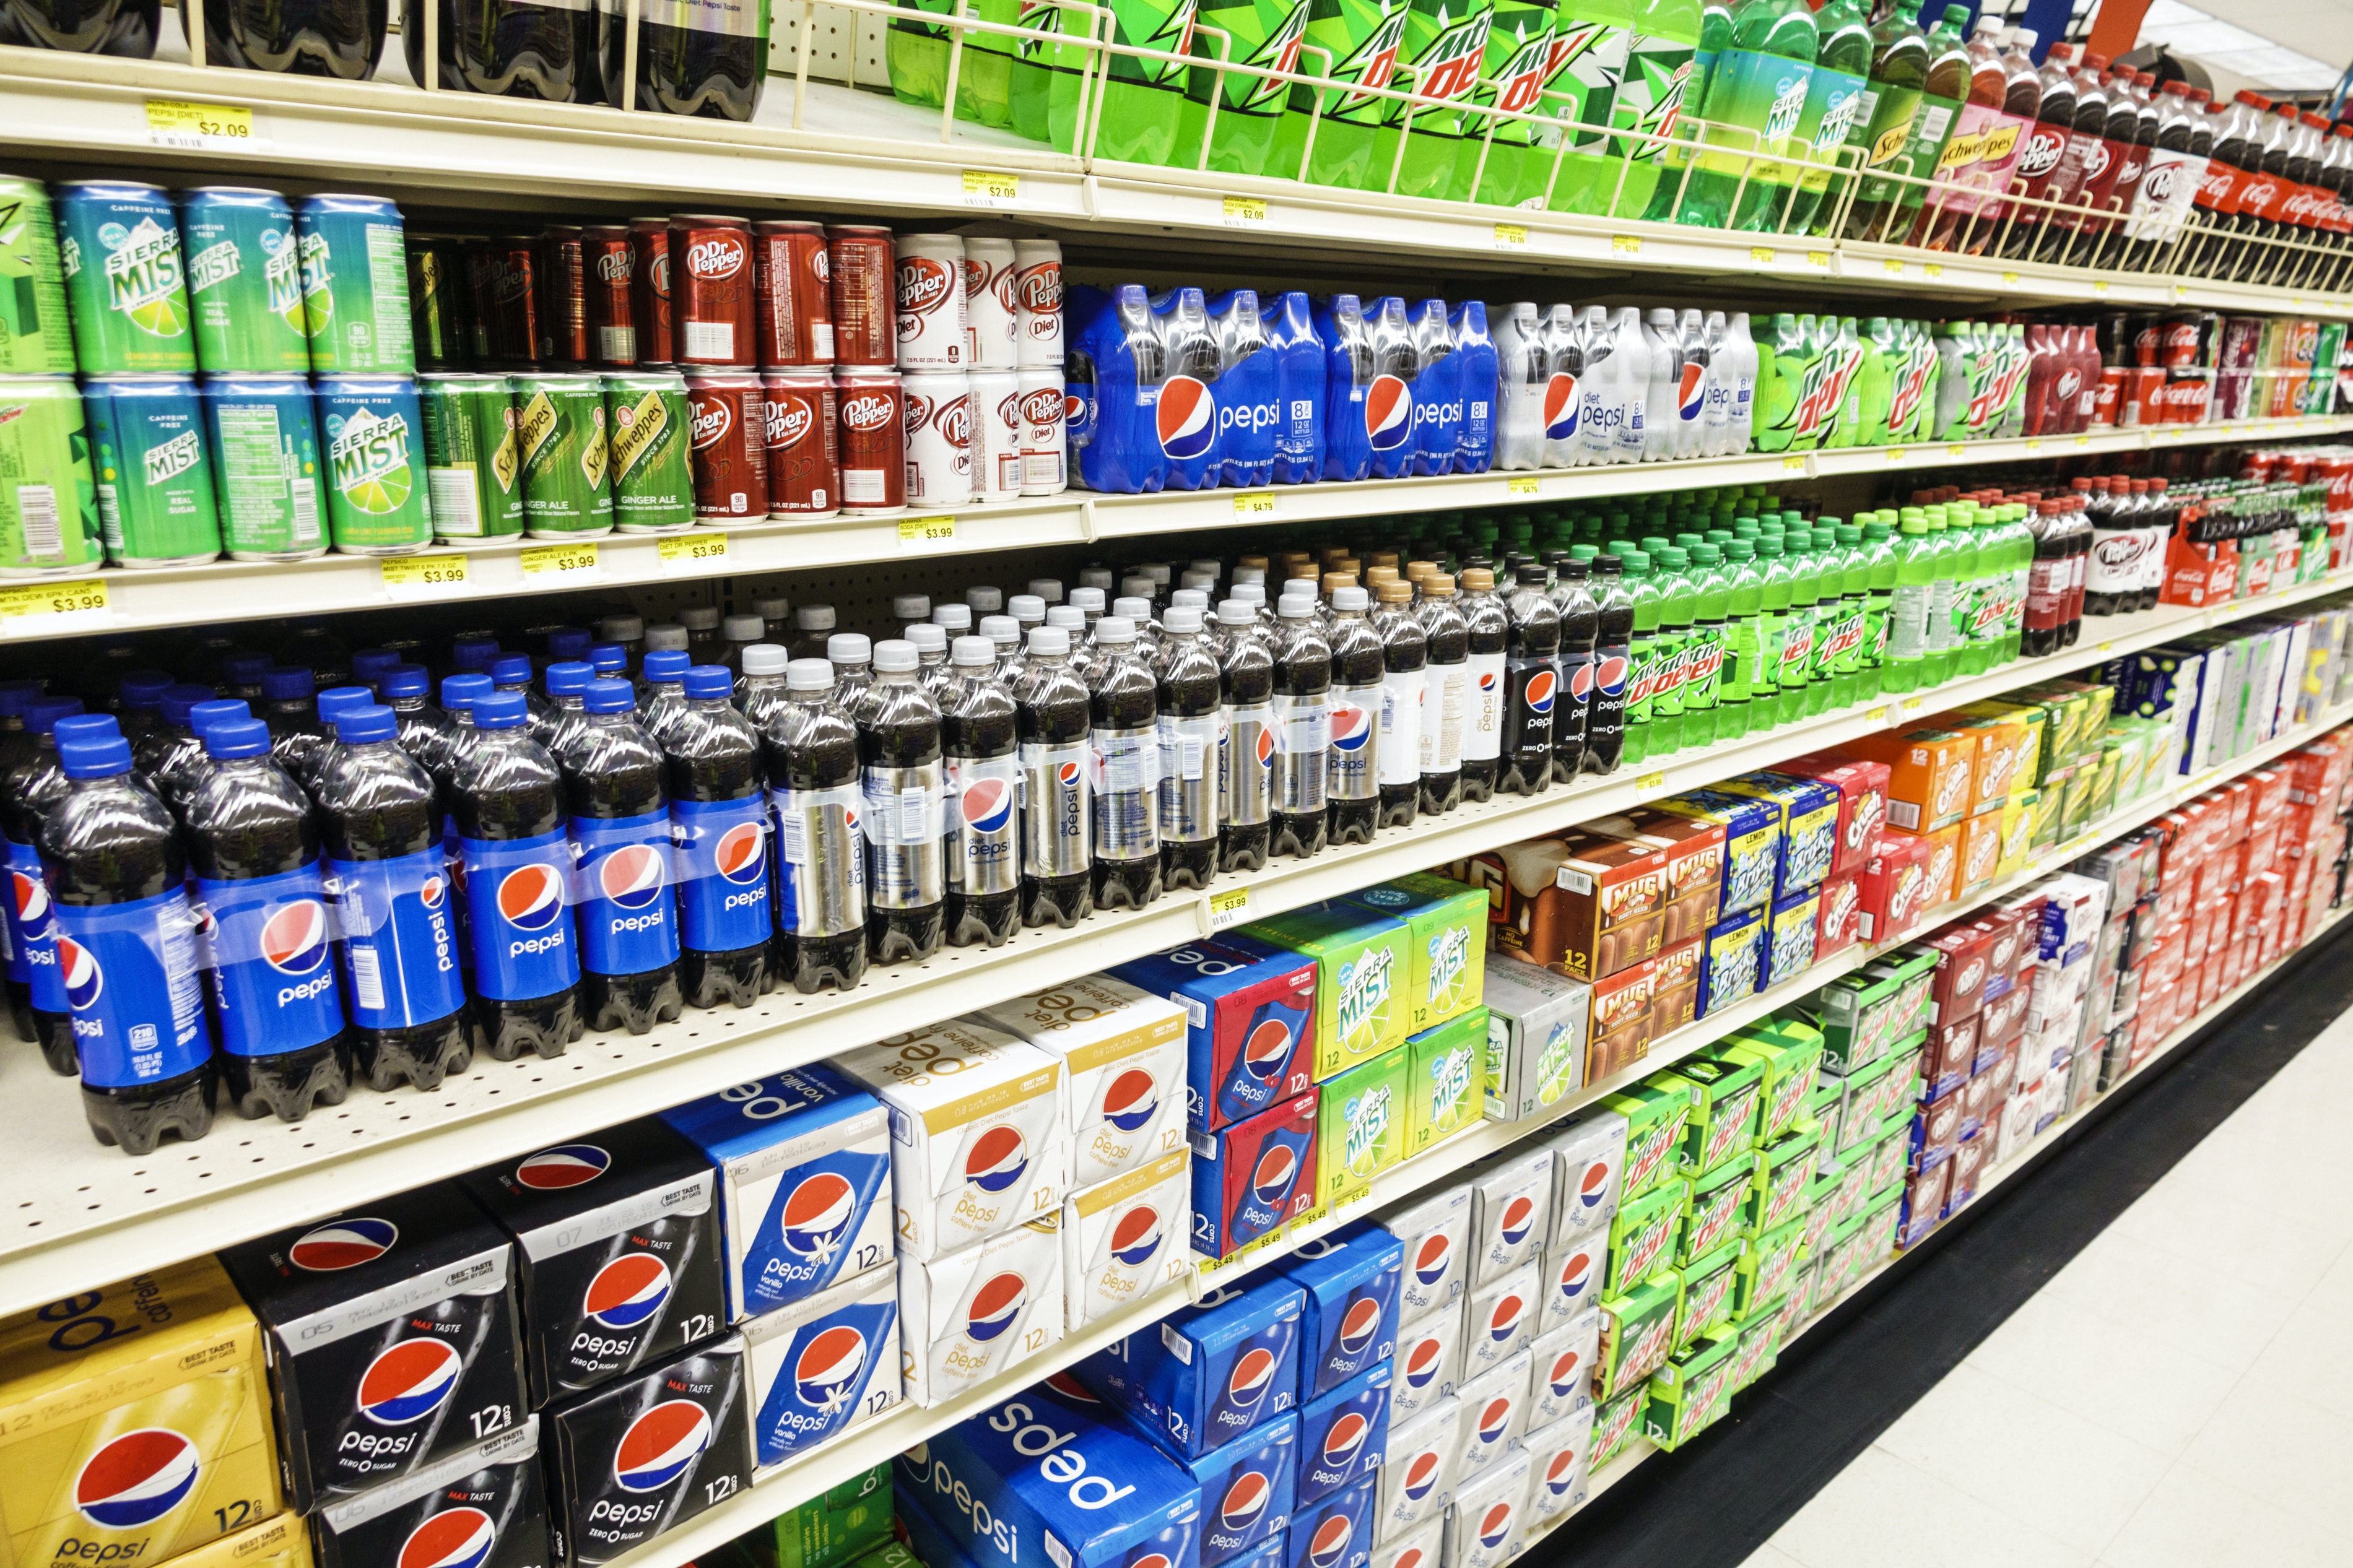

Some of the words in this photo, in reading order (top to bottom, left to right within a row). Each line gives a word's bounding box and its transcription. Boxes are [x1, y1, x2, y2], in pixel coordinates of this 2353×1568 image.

[149, 109, 173, 118] PEPSI
[199, 121, 248, 137] $2.09
[989, 186, 1016, 198] $2.09
[1243, 209, 1264, 220] $2.09
[1509, 235, 1525, 244] $2.09
[111, 229, 180, 270] SIERRA
[191, 243, 233, 271] SIERRA
[706, 241, 729, 260] Dr
[688, 245, 739, 275] Pepper
[191, 249, 237, 294] MIST
[1034, 319, 1055, 336] Diet
[861, 397, 880, 410] Dr
[1584, 392, 1600, 405] diet
[848, 401, 891, 427] Pepper
[1220, 398, 1280, 437] pepsi
[1294, 403, 1303, 418] 8
[1414, 398, 1463, 431] pepsi
[1581, 404, 1625, 433] pepsi
[1634, 403, 1640, 415] 8
[333, 415, 402, 457] SIERRA
[610, 403, 663, 475] Schweppes
[1034, 427, 1050, 438] Diet
[149, 431, 195, 461] SIERRA
[640, 444, 658, 466] SINCE
[658, 428, 671, 445] 1783
[149, 437, 199, 484] MIST
[334, 426, 409, 487] MIST
[171, 496, 193, 505] REAL
[549, 501, 569, 509] ALE
[622, 495, 658, 505] GINGER
[659, 495, 677, 504] ALE
[735, 495, 744, 503] 90
[1253, 503, 1273, 513] $4.79
[169, 505, 197, 514] SUGAR
[926, 527, 952, 539] $3.99
[659, 543, 674, 551] DIET
[692, 544, 724, 558] $3.99
[522, 553, 548, 563] GINGER
[549, 552, 563, 560] ALE
[559, 555, 595, 571] $3.99
[424, 570, 464, 584] $3.99
[22, 592, 44, 601] DEW
[67, 588, 93, 597] CANS
[53, 595, 105, 613] $3.99
[1482, 694, 1493, 732] pepsi
[1598, 698, 1626, 712] pepsi
[1330, 758, 1367, 773] pepsi
[1649, 779, 1663, 789] $3.99
[1064, 789, 1081, 836] pepsi
[1806, 810, 1824, 823] LEMON
[1746, 829, 1767, 845] LEMON
[968, 838, 1011, 859] pepsi
[850, 833, 864, 885] pepsi
[725, 882, 767, 911] pepsi
[1614, 875, 1657, 906] MUG
[1225, 897, 1246, 911] $3.99
[1617, 909, 1633, 920] ROOT
[1633, 903, 1649, 914] BEER
[611, 907, 664, 935] pepsi
[428, 911, 454, 972] pepsi
[510, 927, 565, 959] pepsi
[1497, 935, 1523, 946] CAFFEINE
[1646, 934, 1659, 951] 12
[1564, 949, 1588, 970] 12
[1339, 946, 1393, 1005] SIERRA
[1564, 965, 1586, 977] PACK
[278, 968, 333, 1008] pepsi
[1338, 959, 1393, 1031] MIST
[1327, 1052, 1340, 1068] 12
[1232, 1077, 1268, 1102] pepsi
[1290, 1072, 1305, 1093] 12
[1161, 1129, 1176, 1151] 12
[664, 1190, 682, 1202] BEST
[682, 1183, 701, 1195] TASTE
[1352, 1189, 1370, 1203] $5.49
[954, 1198, 1001, 1224] pepsi
[1243, 1205, 1274, 1227] pepsi
[1308, 1209, 1326, 1224] $5.49
[1261, 1232, 1281, 1248] $5.49
[763, 1256, 819, 1282] pepsi
[1213, 1254, 1233, 1270] $5.49
[760, 1275, 783, 1289] vanilla
[412, 1319, 434, 1330] MAX
[434, 1323, 463, 1334] TASTE
[185, 1350, 207, 1364] BEST
[209, 1340, 237, 1357] TASTE
[570, 1332, 635, 1358] pepsi
[1274, 1390, 1287, 1414] 12
[777, 1410, 830, 1432] pepsi
[1168, 1404, 1184, 1439] 12
[1217, 1408, 1250, 1429] pepsi
[338, 1431, 419, 1458] pepsi
[484, 1437, 502, 1451] BEST
[503, 1429, 525, 1445] TASTE
[339, 1458, 359, 1470] ZERO
[372, 1462, 398, 1471] SUGAR
[1311, 1470, 1342, 1486] pepsi
[448, 1491, 469, 1502] MAX
[469, 1492, 495, 1502] TASTE
[589, 1498, 664, 1525] pepsi
[935, 1460, 1017, 1564] pepsi
[56, 1537, 152, 1566] pepsi
